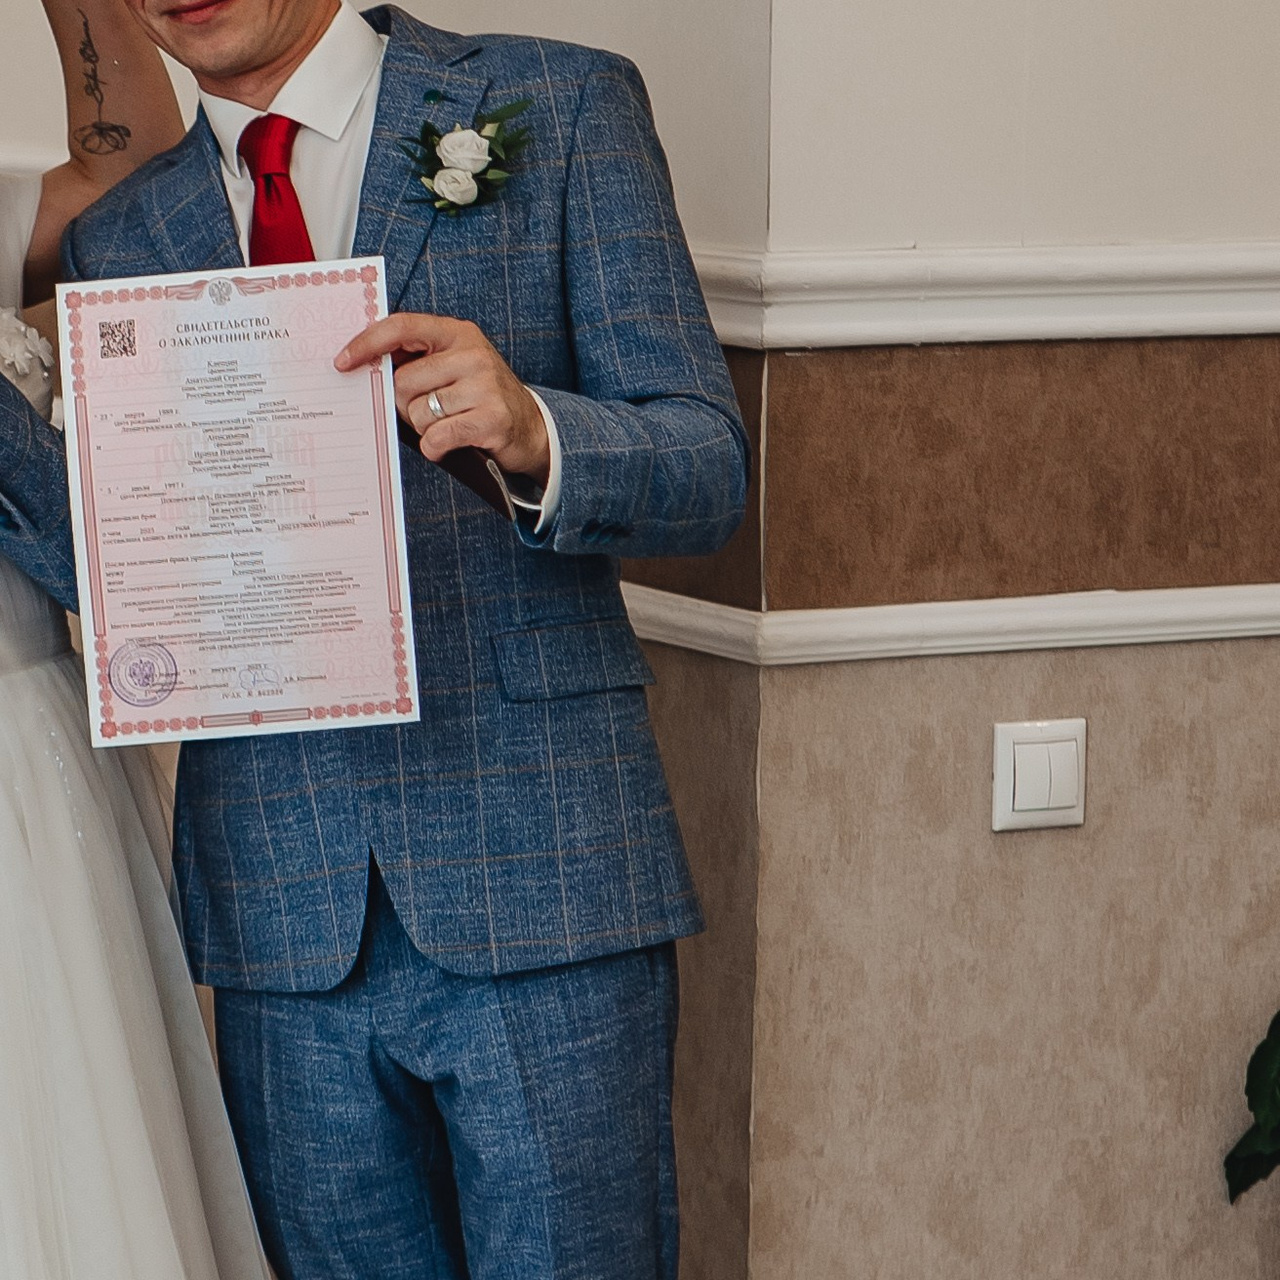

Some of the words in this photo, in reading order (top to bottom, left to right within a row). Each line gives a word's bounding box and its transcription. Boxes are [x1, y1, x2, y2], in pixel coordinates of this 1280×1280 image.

[176, 317, 271, 334] СВИДЕТЕЛЬСТВО
[159, 340, 167, 349] О
[171, 332, 250, 348] ЗАКЛЮЧЕНИИ
[254, 328, 290, 340] БРАКА
